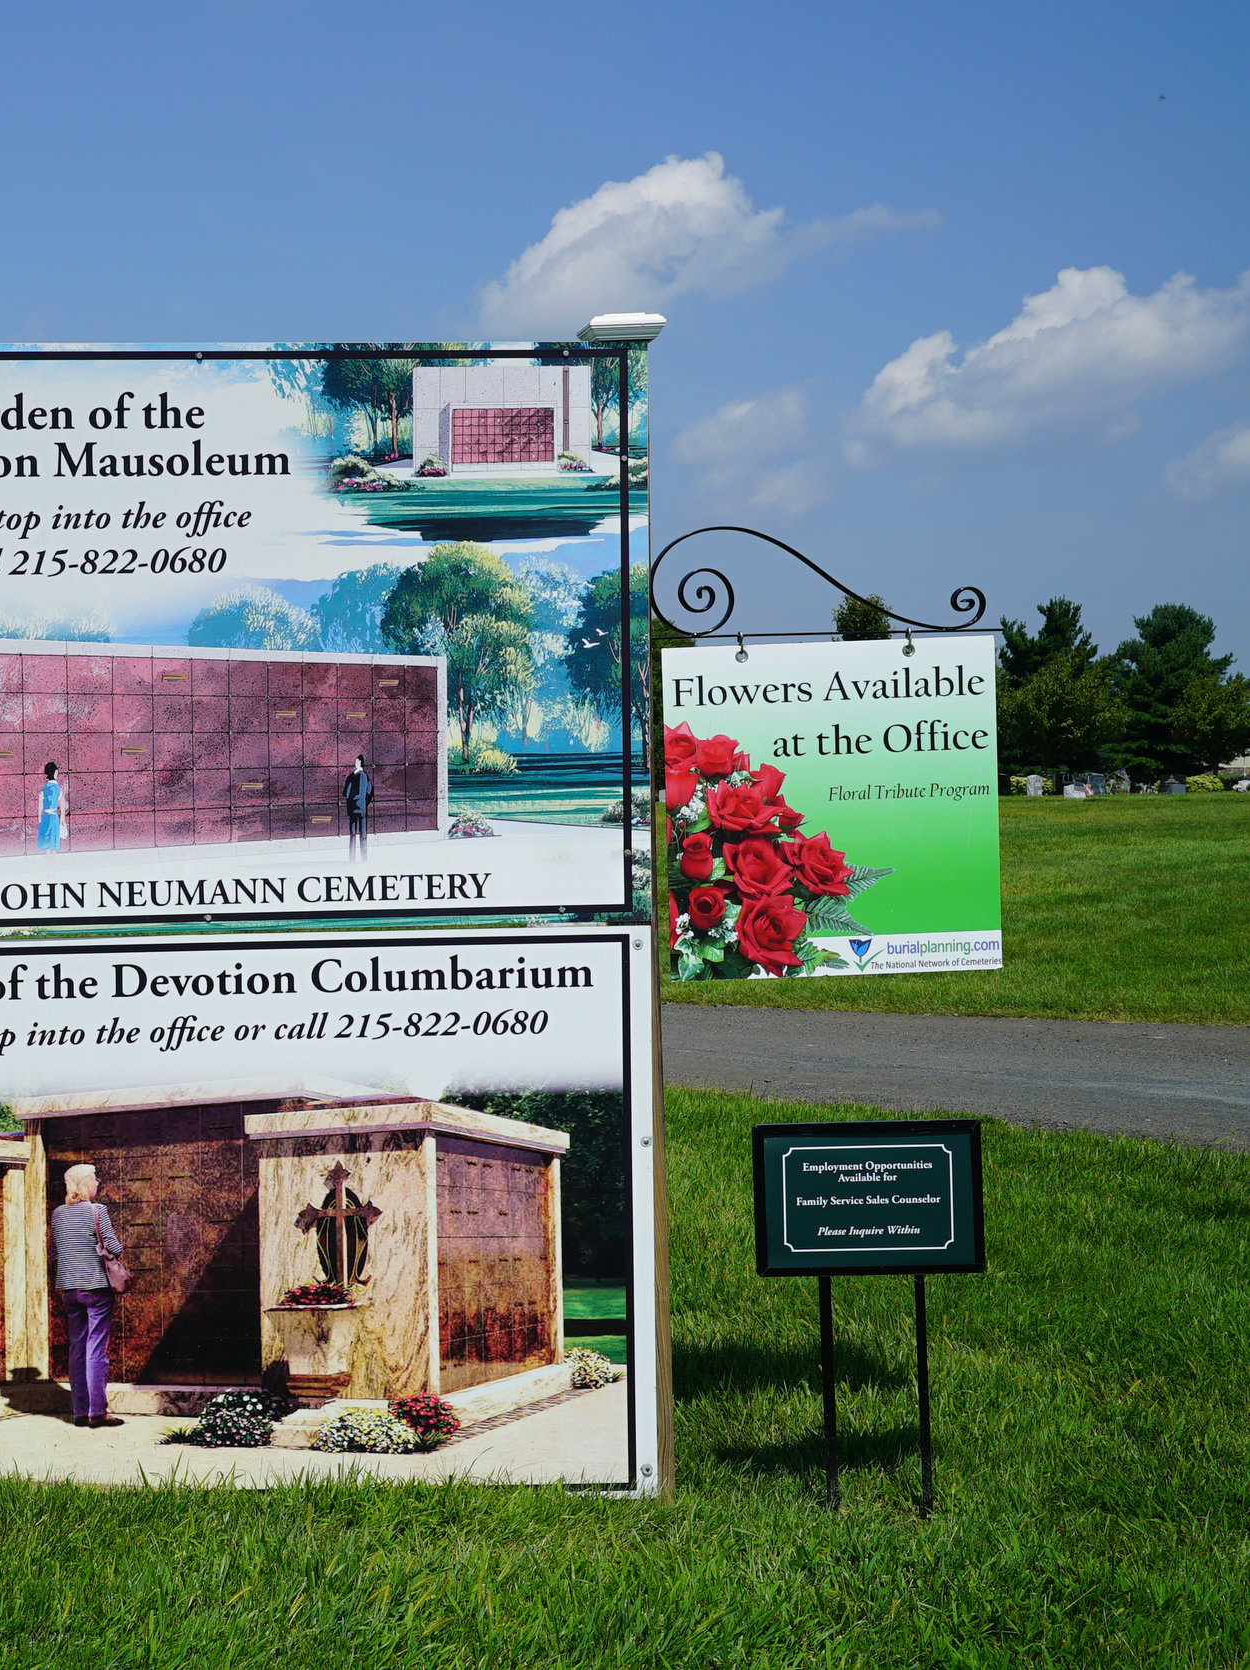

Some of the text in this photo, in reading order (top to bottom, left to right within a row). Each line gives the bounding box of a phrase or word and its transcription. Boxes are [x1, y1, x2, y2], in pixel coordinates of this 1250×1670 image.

[88, 391, 134, 430] of
[143, 392, 204, 429] the
[54, 439, 291, 477] Mausoleum
[52, 505, 110, 529] into
[122, 501, 166, 529] the
[176, 500, 252, 538] office
[8, 547, 226, 577] 215-822-0680
[672, 665, 984, 707] Flowers Available
[774, 720, 988, 757] at the Office
[829, 783, 989, 801] Floral Tribute Program
[97, 879, 286, 908] NEUMANN
[297, 873, 491, 904] CEMETERY
[871, 957, 1002, 970] The National Network of Cemeteries
[887, 940, 1000, 956] burialplanning.com
[35, 963, 98, 999] the
[112, 963, 297, 997] Devotion
[311, 954, 594, 993] Columbarium
[27, 1022, 85, 1046] into
[96, 1017, 140, 1044] the
[150, 1015, 225, 1052] office
[235, 1025, 266, 1041] or
[274, 1012, 328, 1040] call
[334, 1009, 548, 1040] 215-822-0680
[802, 1160, 933, 1173] Employment Opportunities
[838, 1172, 898, 1183] Available for
[796, 1194, 941, 1208] Family Service Sales Counselor
[817, 1225, 921, 1238] Please Inquire Within
